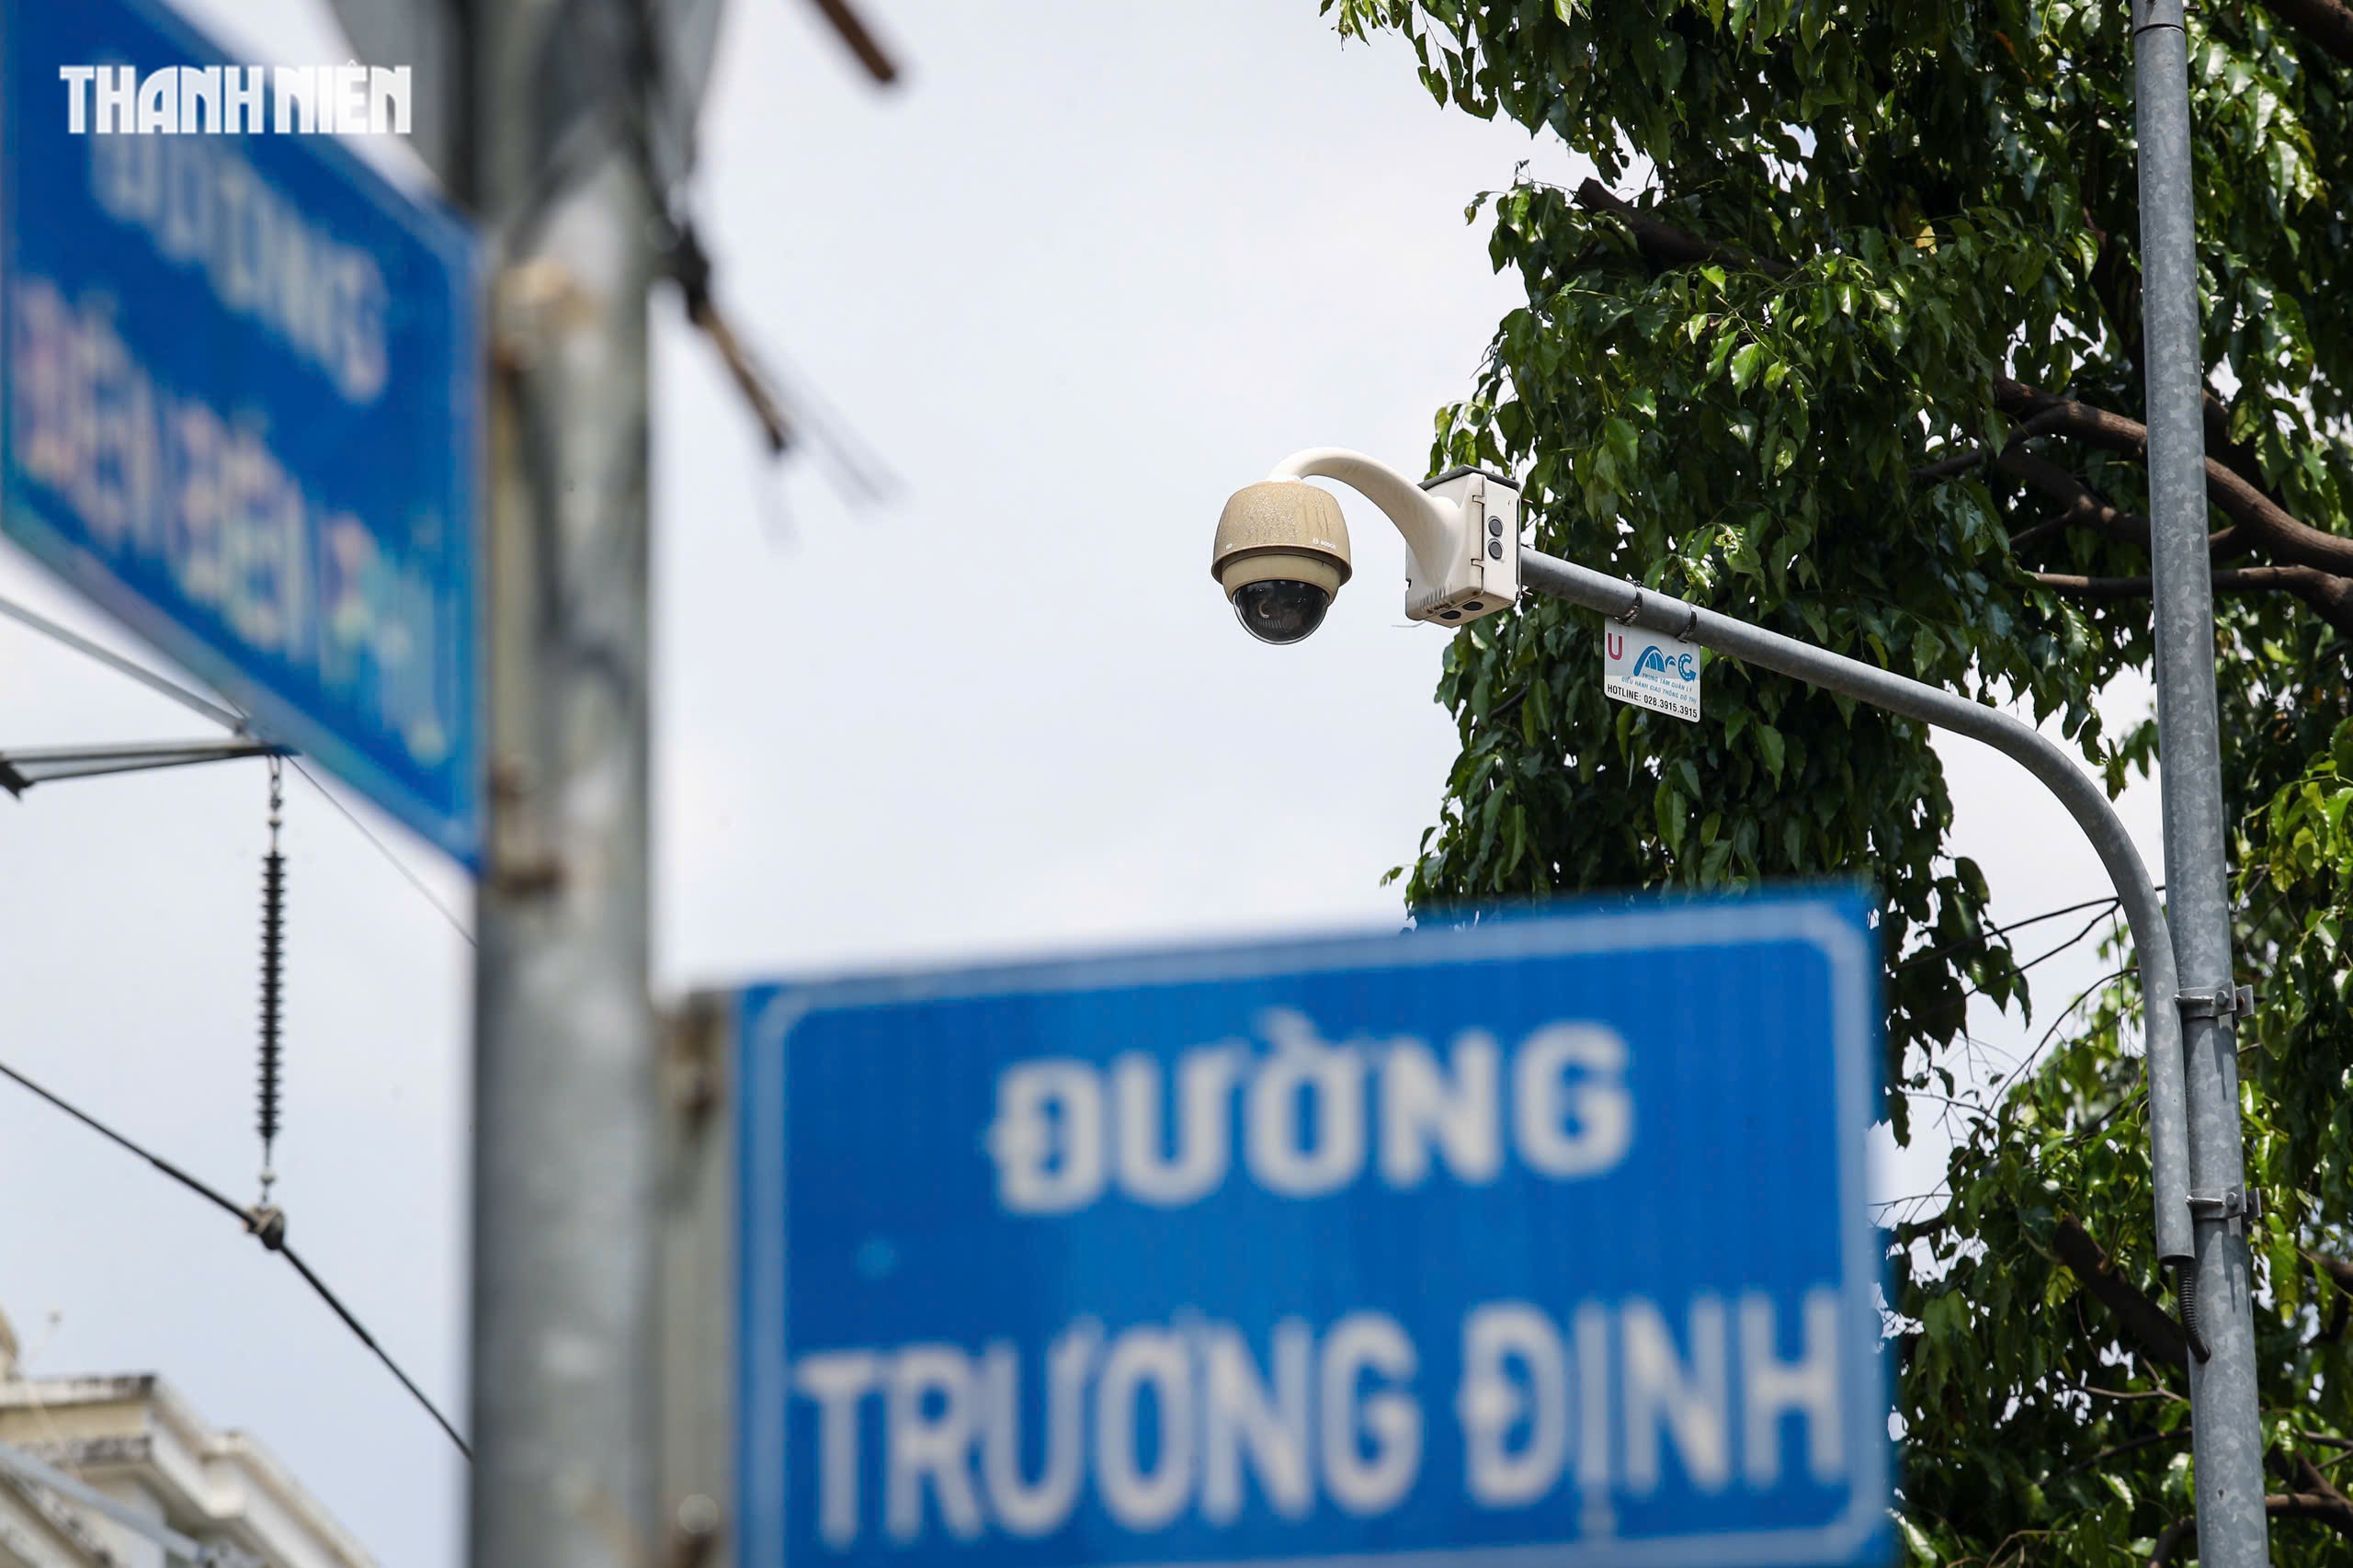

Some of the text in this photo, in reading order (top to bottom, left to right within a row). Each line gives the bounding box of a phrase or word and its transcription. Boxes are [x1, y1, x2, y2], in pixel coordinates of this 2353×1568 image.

[1608, 683, 1698, 718] HOTLINE: 028.3915.3915
[988, 1006, 1636, 1215] ĐƯỜNG
[792, 1287, 1843, 1550] TRƯƠNG ĐỊNH
